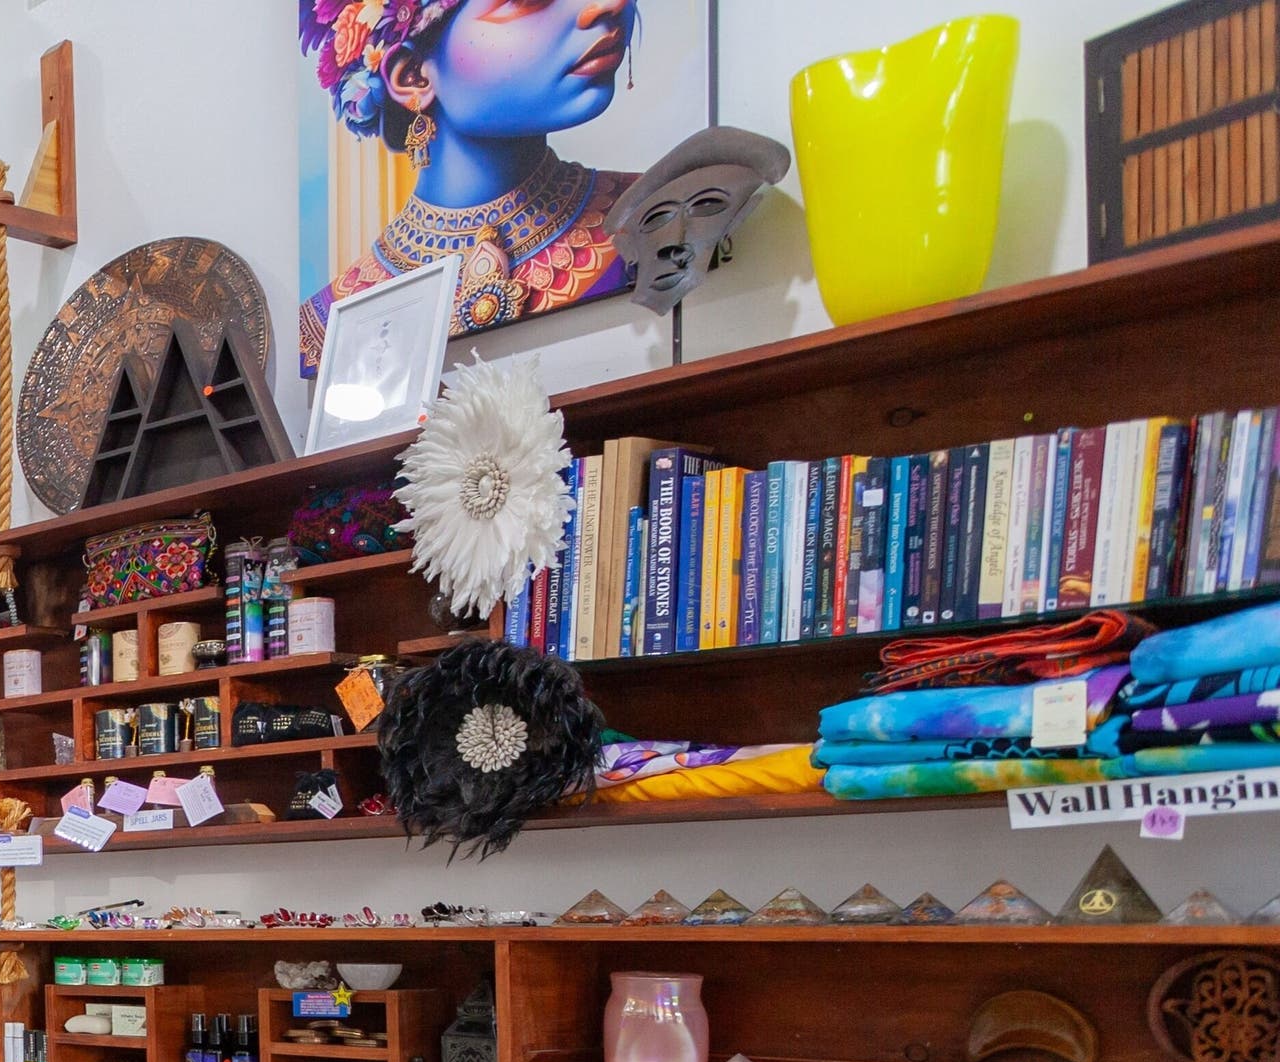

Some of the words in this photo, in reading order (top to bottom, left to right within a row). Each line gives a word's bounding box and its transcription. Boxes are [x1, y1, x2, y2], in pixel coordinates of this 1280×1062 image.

[589, 468, 598, 487] THE
[684, 456, 701, 475] THE
[1072, 458, 1083, 490] SECRET
[660, 477, 673, 505] THE
[769, 478, 781, 508] JOHN
[809, 467, 818, 498] MAGIC
[825, 465, 839, 511] ELEMENTS
[931, 473, 941, 515] ASPECTING
[992, 471, 1008, 525] Knowledge
[585, 489, 596, 532] HEALING
[749, 481, 761, 536] ASTROLOGY
[769, 510, 778, 523] OF
[892, 493, 902, 522] Journey
[1071, 492, 1081, 519] SIGNS
[659, 508, 672, 545] BOOK
[807, 522, 816, 546] IRON
[823, 518, 833, 548] MAGIC
[892, 524, 900, 539] Into
[930, 516, 938, 531] THE
[990, 529, 1004, 539] of
[584, 534, 594, 567] POWER
[658, 547, 670, 564] OF
[767, 527, 779, 553] GOD
[928, 533, 937, 569] GODDESS
[1065, 530, 1078, 571] SYMBOLS
[804, 549, 814, 592] PENTACLE
[890, 540, 900, 573] Oneness
[988, 544, 1003, 576] Angels
[656, 567, 669, 616] STONES
[745, 568, 756, 600] FAMED
[1017, 785, 1110, 816] Wall
